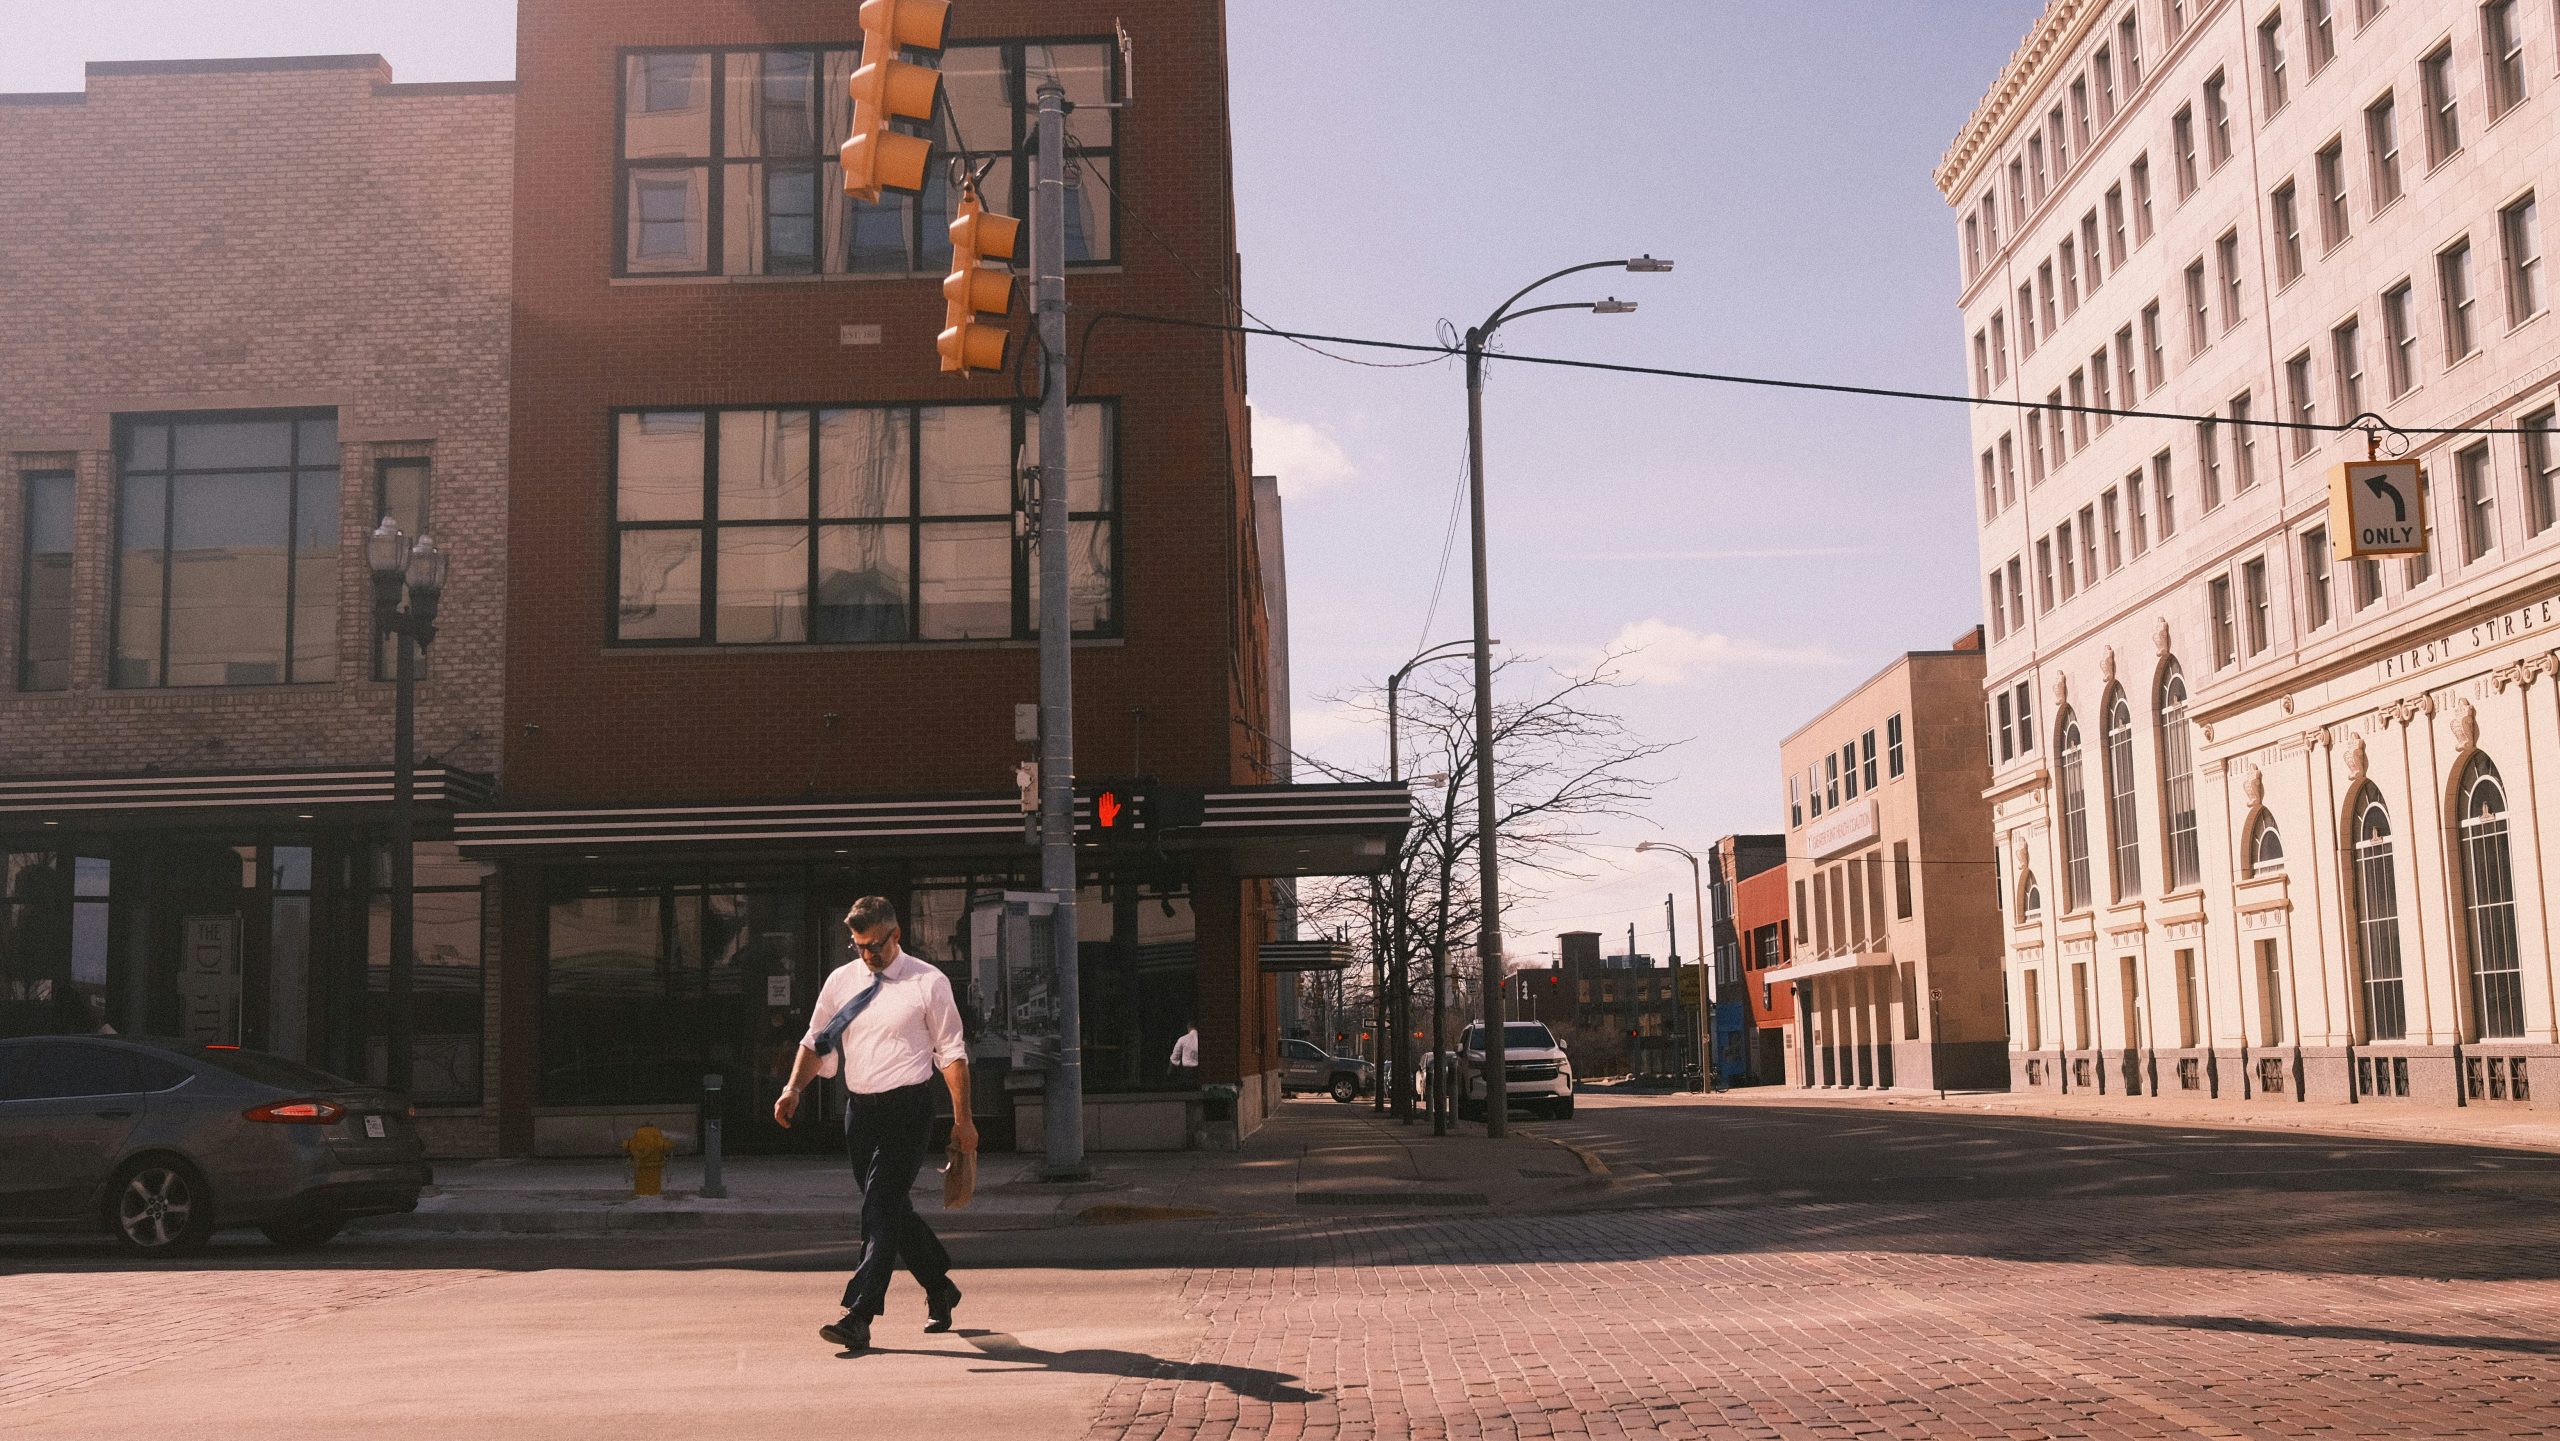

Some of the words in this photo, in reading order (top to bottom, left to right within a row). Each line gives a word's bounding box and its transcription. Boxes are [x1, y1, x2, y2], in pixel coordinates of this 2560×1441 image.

[2362, 526, 2413, 545] ONLY
[2386, 637, 2450, 678] FIRST
[2471, 596, 2560, 647] STREE
[198, 923, 222, 941] THE
[1521, 980, 1529, 1001] 444
